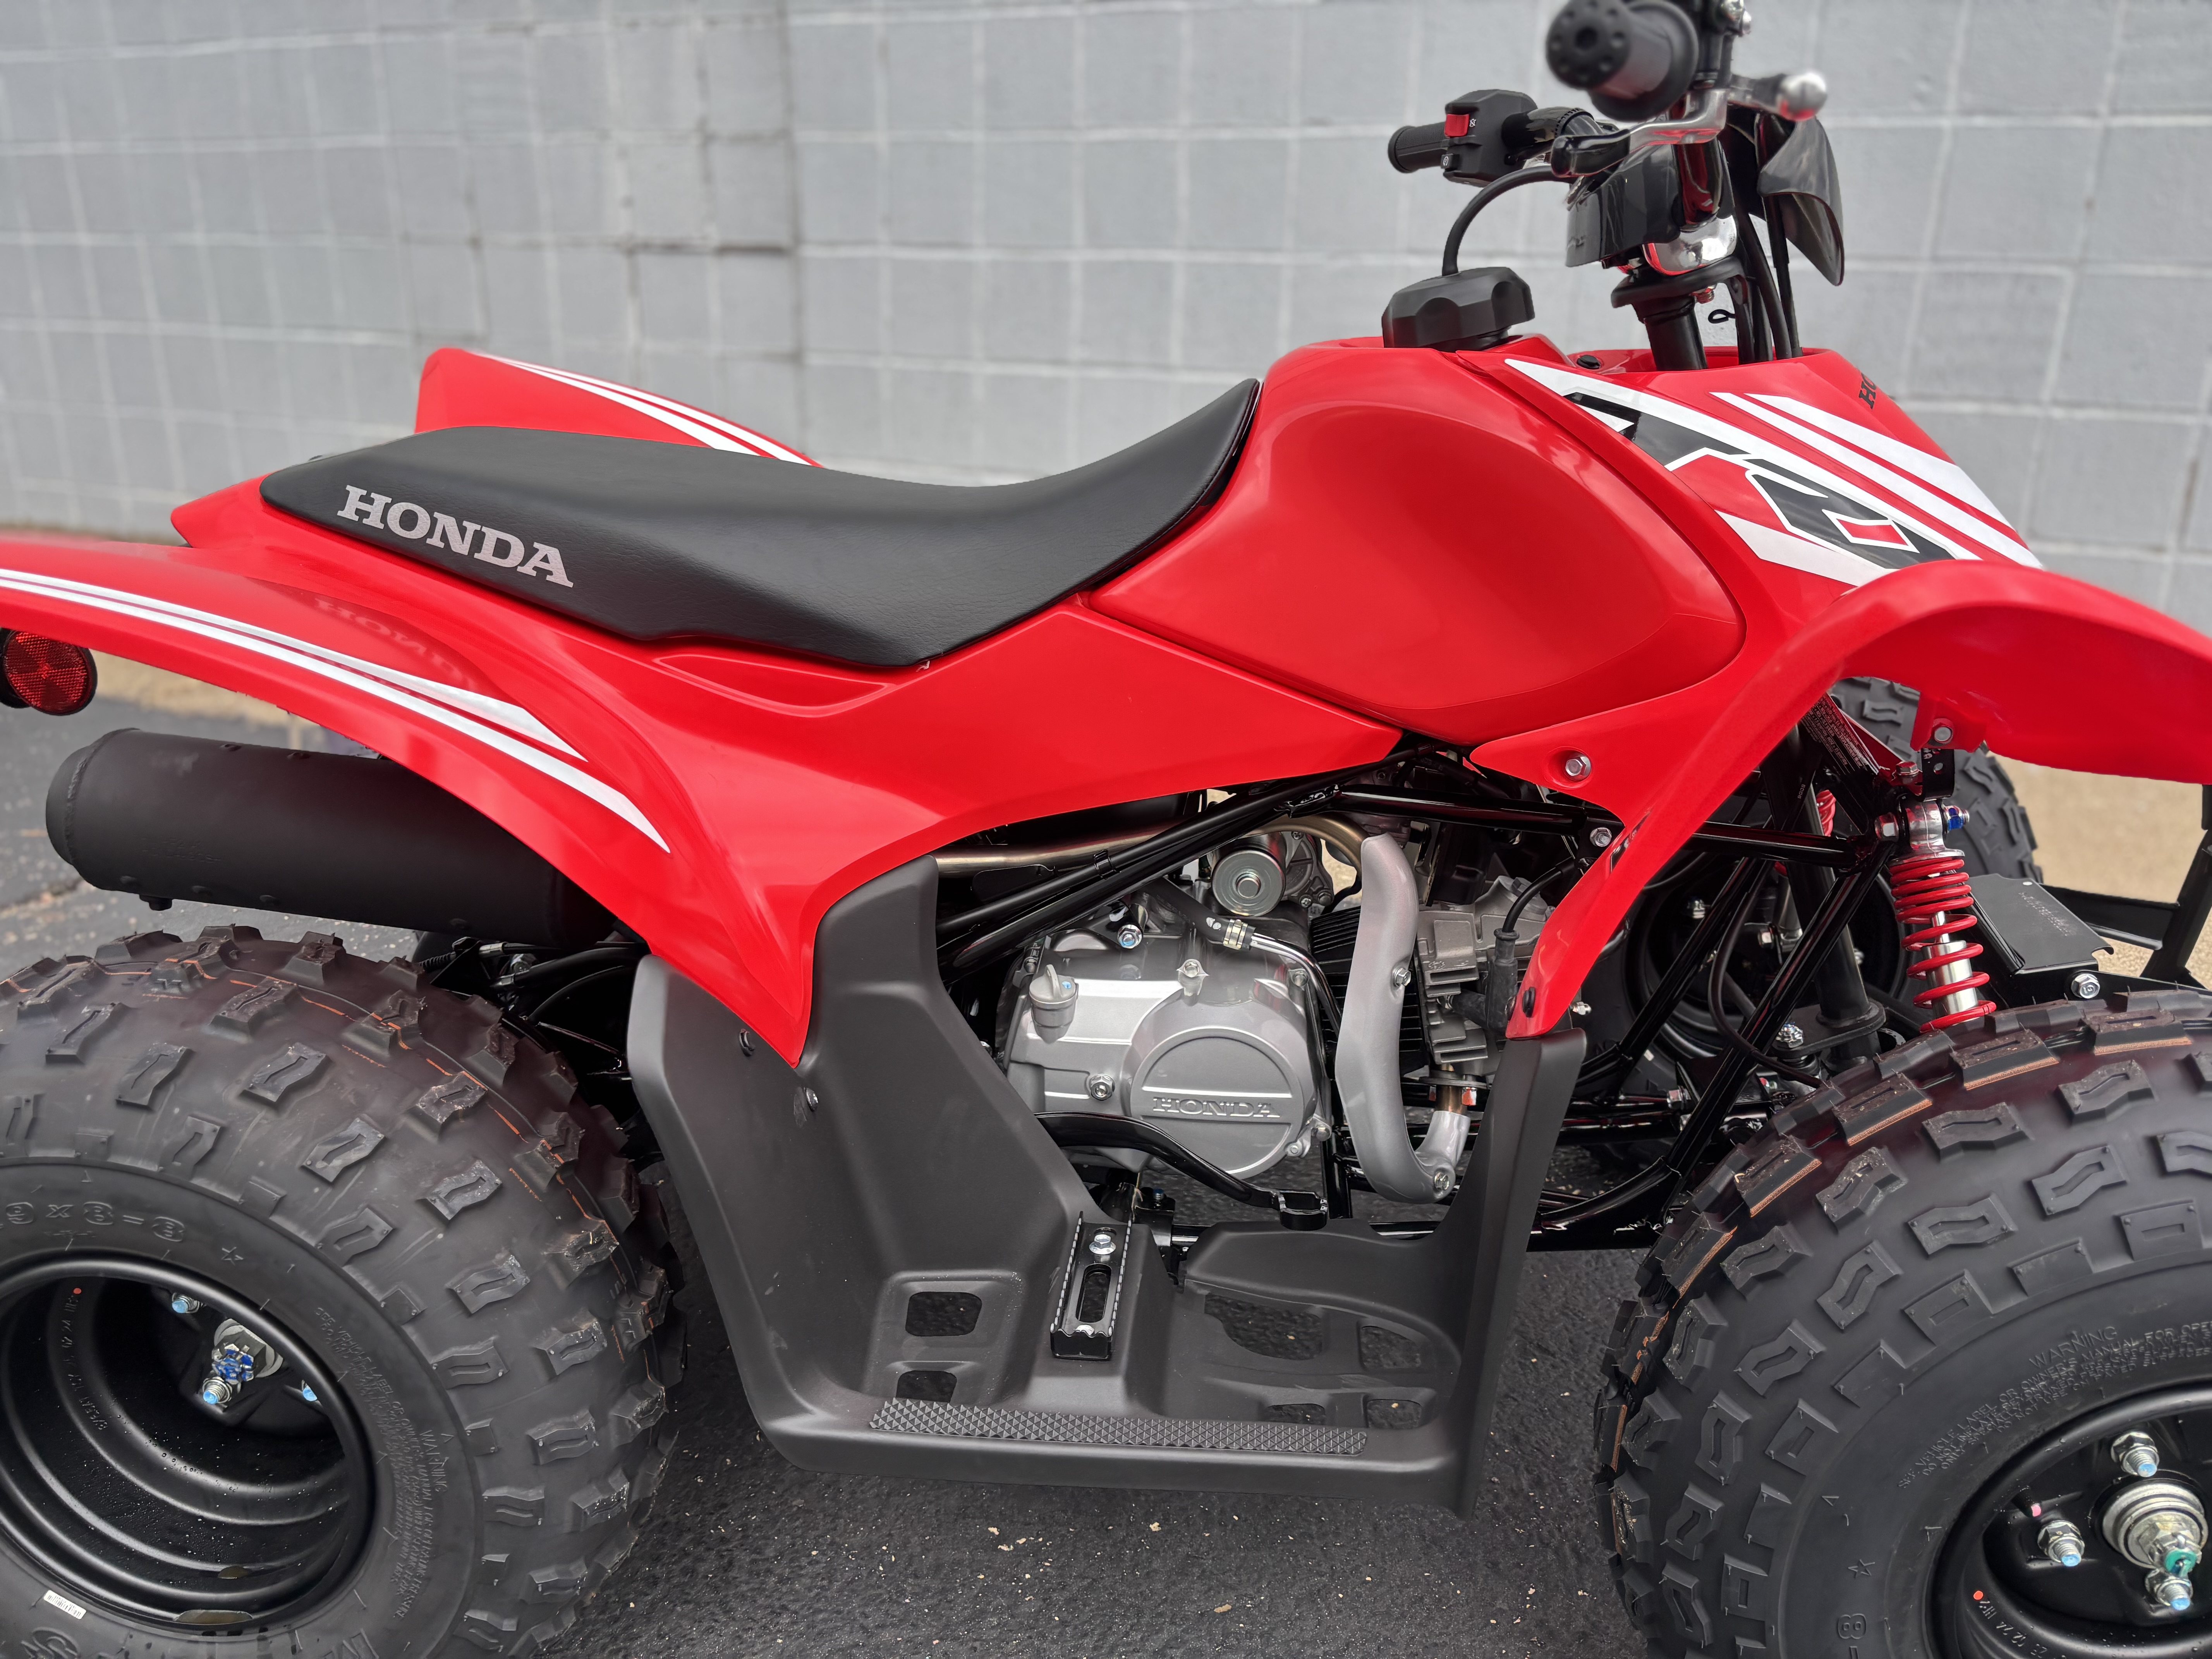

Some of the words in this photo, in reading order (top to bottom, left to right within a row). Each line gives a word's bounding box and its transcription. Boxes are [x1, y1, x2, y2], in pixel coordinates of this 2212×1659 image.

[337, 485, 574, 587] HONDA
[1153, 1097, 1280, 1117] HONDA
[2029, 1326, 2117, 1369] WARNING
[1915, 1429, 1955, 1466] VEHICLE
[1957, 1404, 1997, 1431] LABEL
[1999, 1388, 2017, 1402] OR
[2021, 1358, 2078, 1389] OWNER'S
[2081, 1338, 2142, 1361] MANUAL
[2145, 1328, 2175, 1344] FOR
[2181, 1321, 2212, 1336] OPE
[2015, 1403, 2039, 1421] NOT
[419, 1430, 448, 1492] WARNING
[1922, 1463, 1937, 1476] DO
